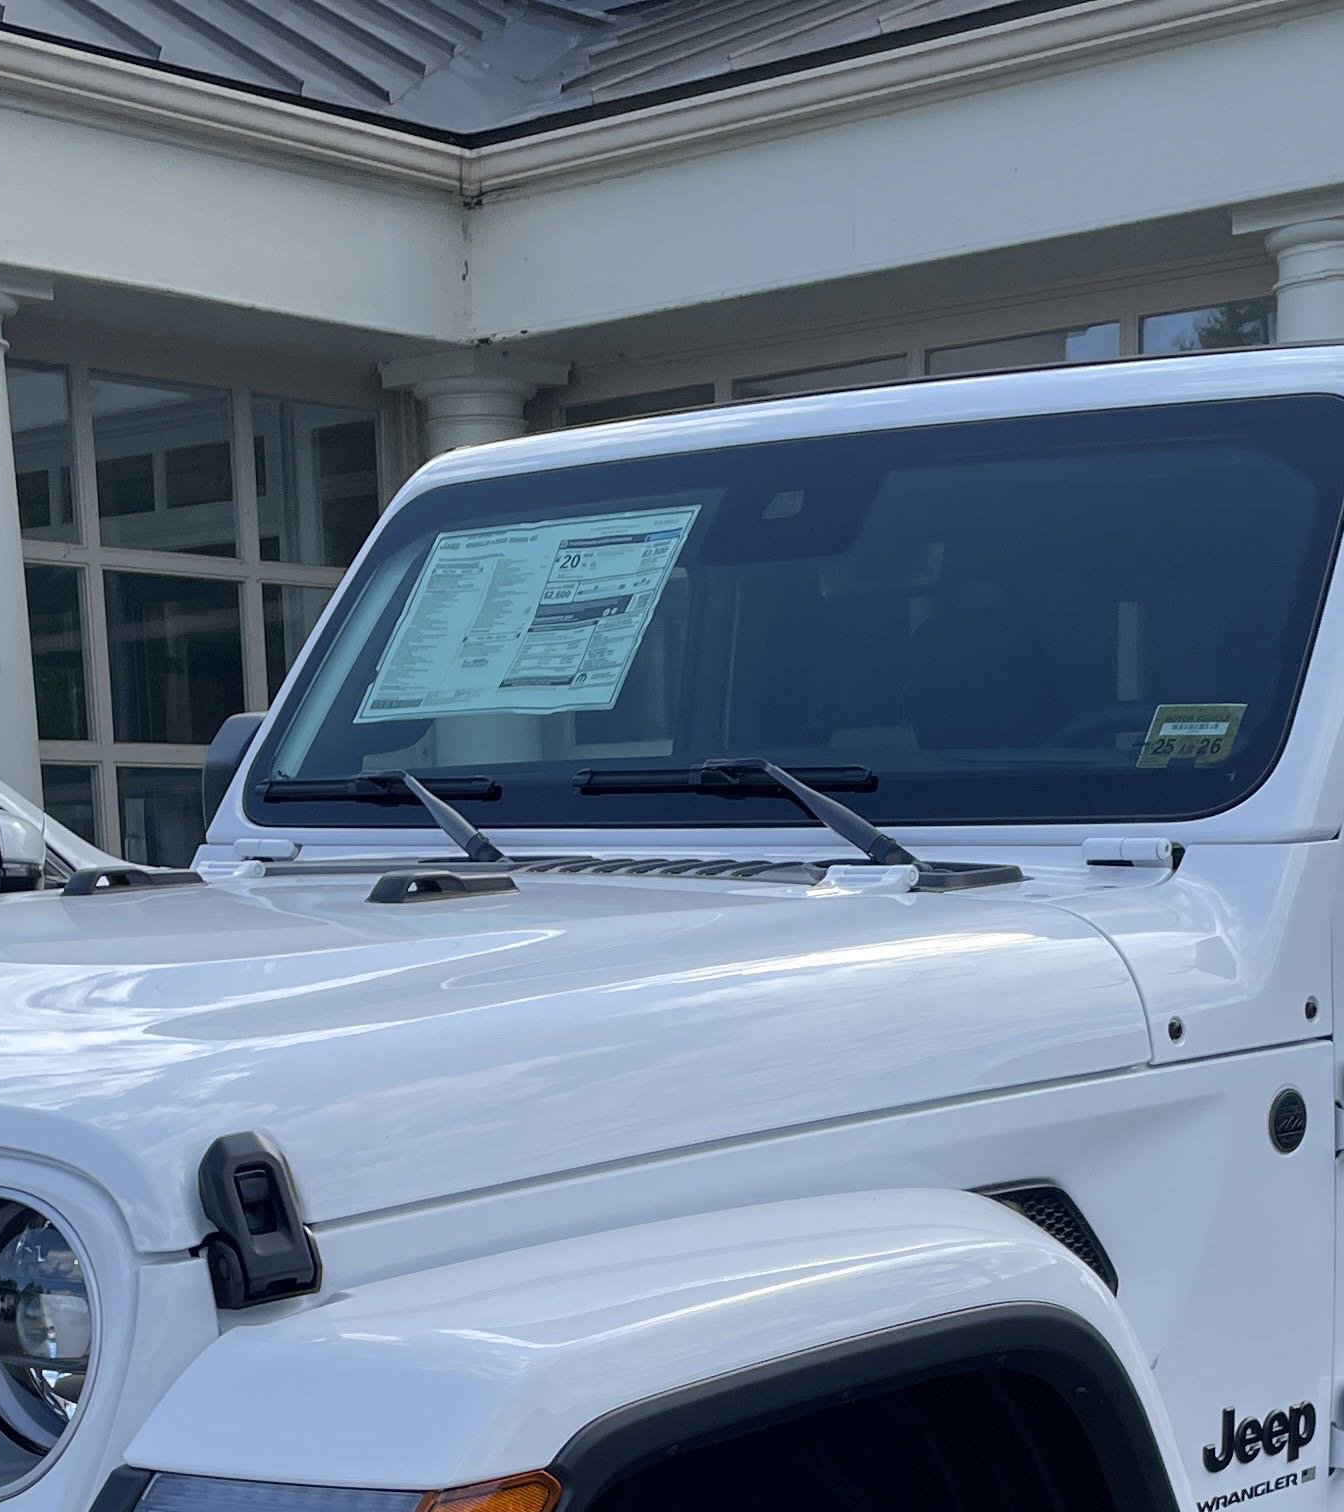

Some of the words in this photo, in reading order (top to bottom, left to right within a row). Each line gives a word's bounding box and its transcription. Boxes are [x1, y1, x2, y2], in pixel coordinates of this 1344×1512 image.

[559, 554, 581, 569] 20
[1152, 738, 1176, 755] 25
[1202, 1400, 1317, 1473] Jeep
